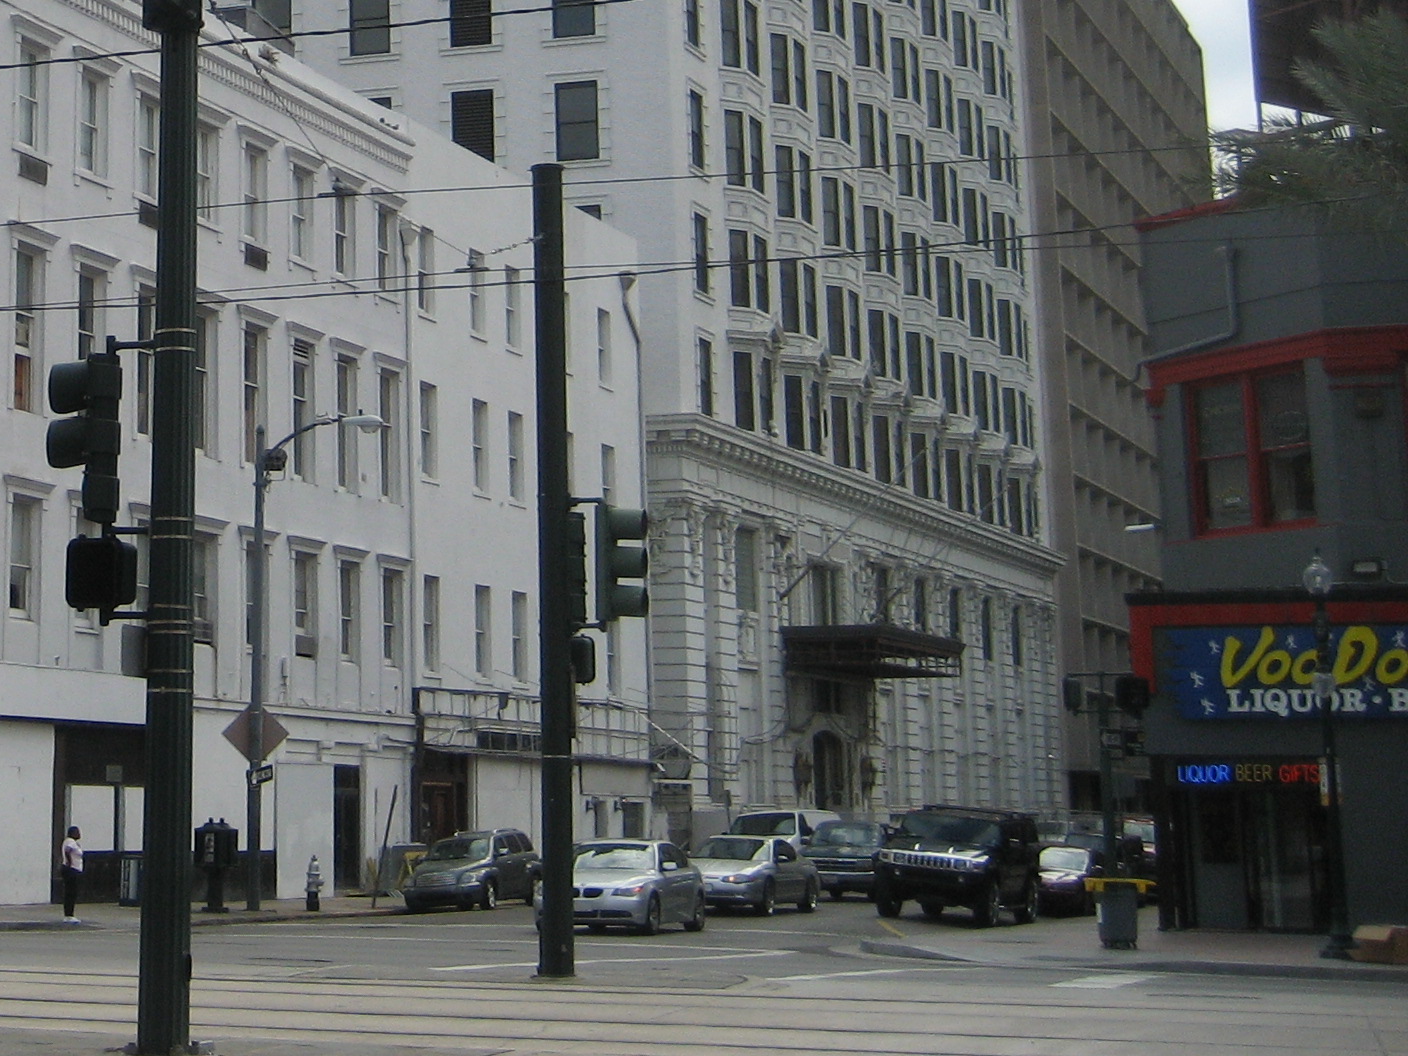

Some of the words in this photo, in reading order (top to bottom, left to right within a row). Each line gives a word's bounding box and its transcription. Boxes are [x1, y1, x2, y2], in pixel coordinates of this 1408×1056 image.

[1225, 687, 1367, 717] LIQUOR
[1177, 764, 1231, 783] LIQUOR
[1235, 763, 1273, 781] BEER
[1278, 763, 1321, 784] GIFTS
